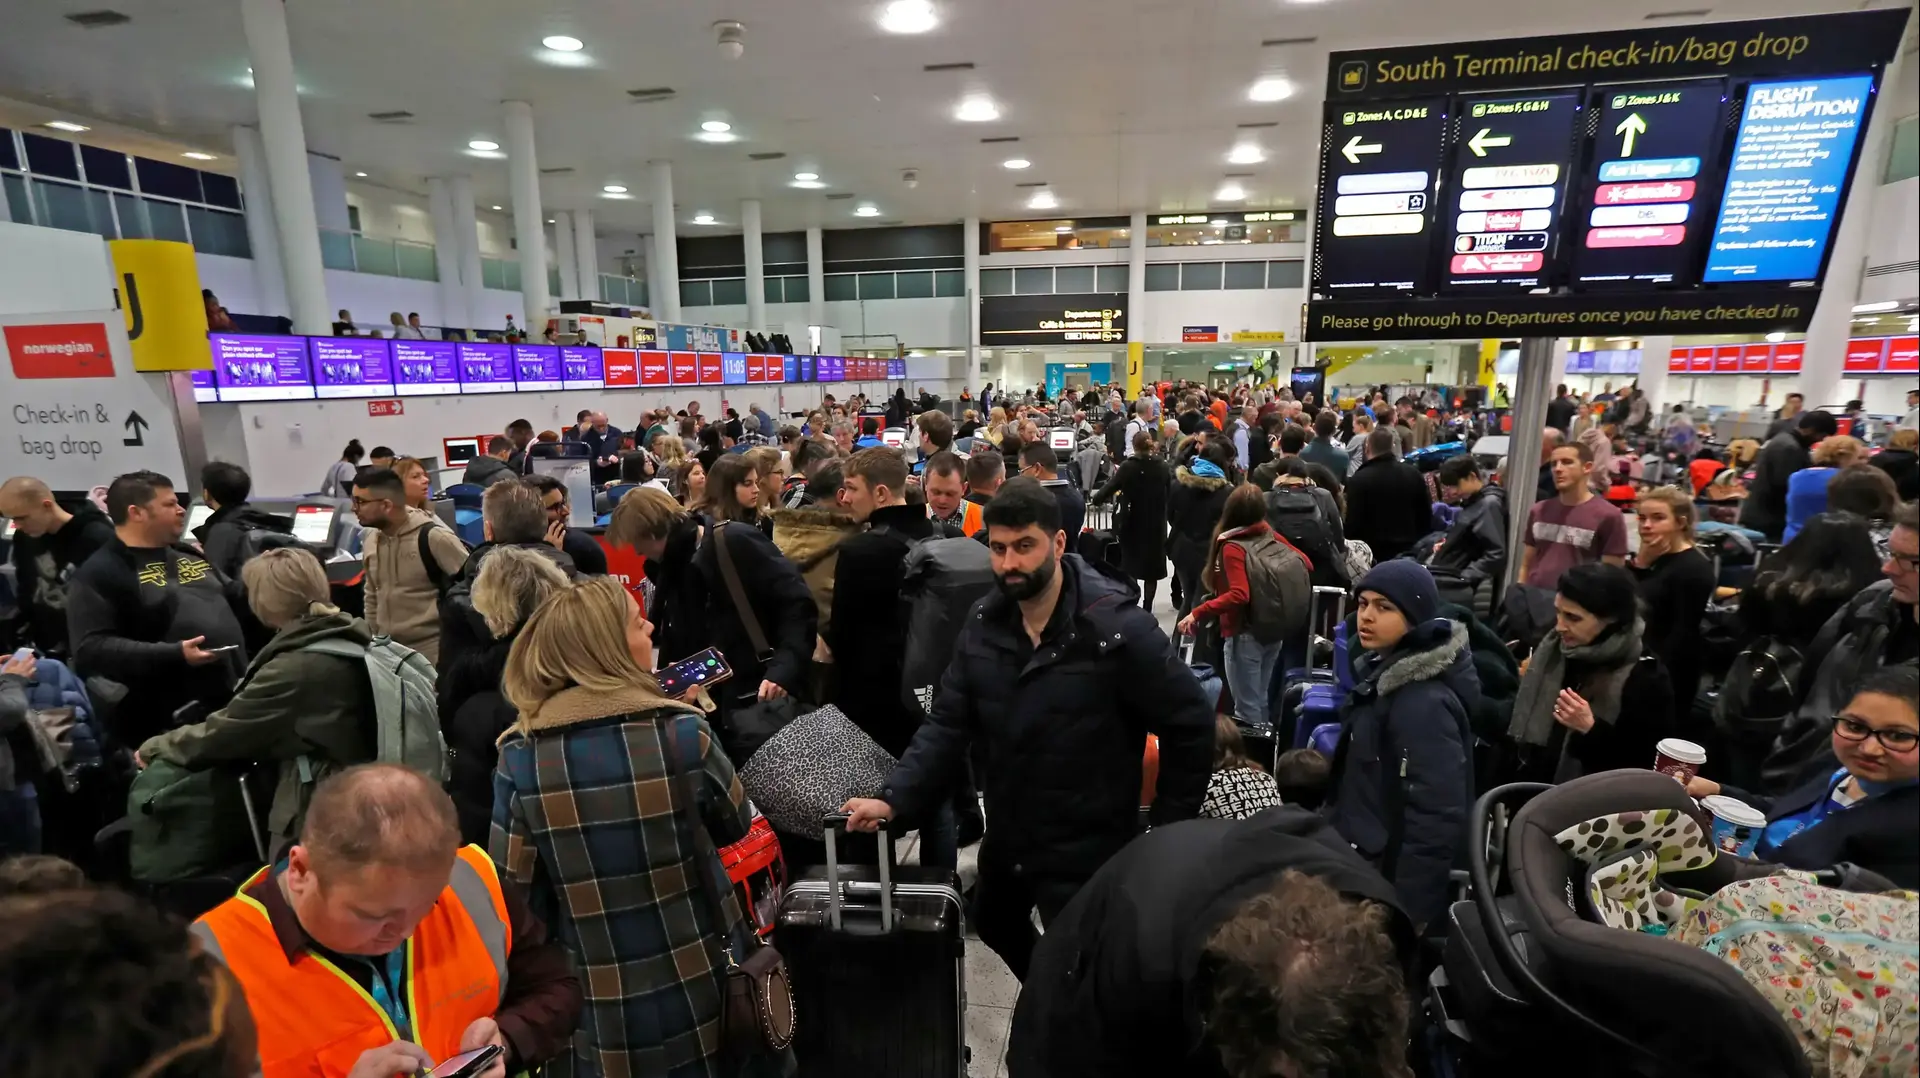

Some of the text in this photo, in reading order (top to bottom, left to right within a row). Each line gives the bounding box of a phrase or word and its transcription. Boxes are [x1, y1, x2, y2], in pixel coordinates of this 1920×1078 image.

[1376, 33, 1808, 83] South Terminal check-in/bag drop
[1627, 95, 1656, 106] Zones
[1752, 86, 1818, 105] FLIGHT
[1357, 111, 1383, 122] Zones
[1487, 104, 1514, 114] Zones
[1747, 98, 1859, 120] DISRUPTION
[123, 273, 144, 340] J
[1321, 303, 1799, 333] Please go through to Departures once you have checked in
[23, 340, 95, 356] norwegian
[725, 359, 745, 374] 11:05
[1129, 361, 1137, 376] J
[1485, 358, 1496, 373] K
[13, 403, 110, 425] Check-in &
[370, 403, 387, 413] Exit
[20, 434, 103, 461] bag drop
[924, 684, 934, 714] adidas
